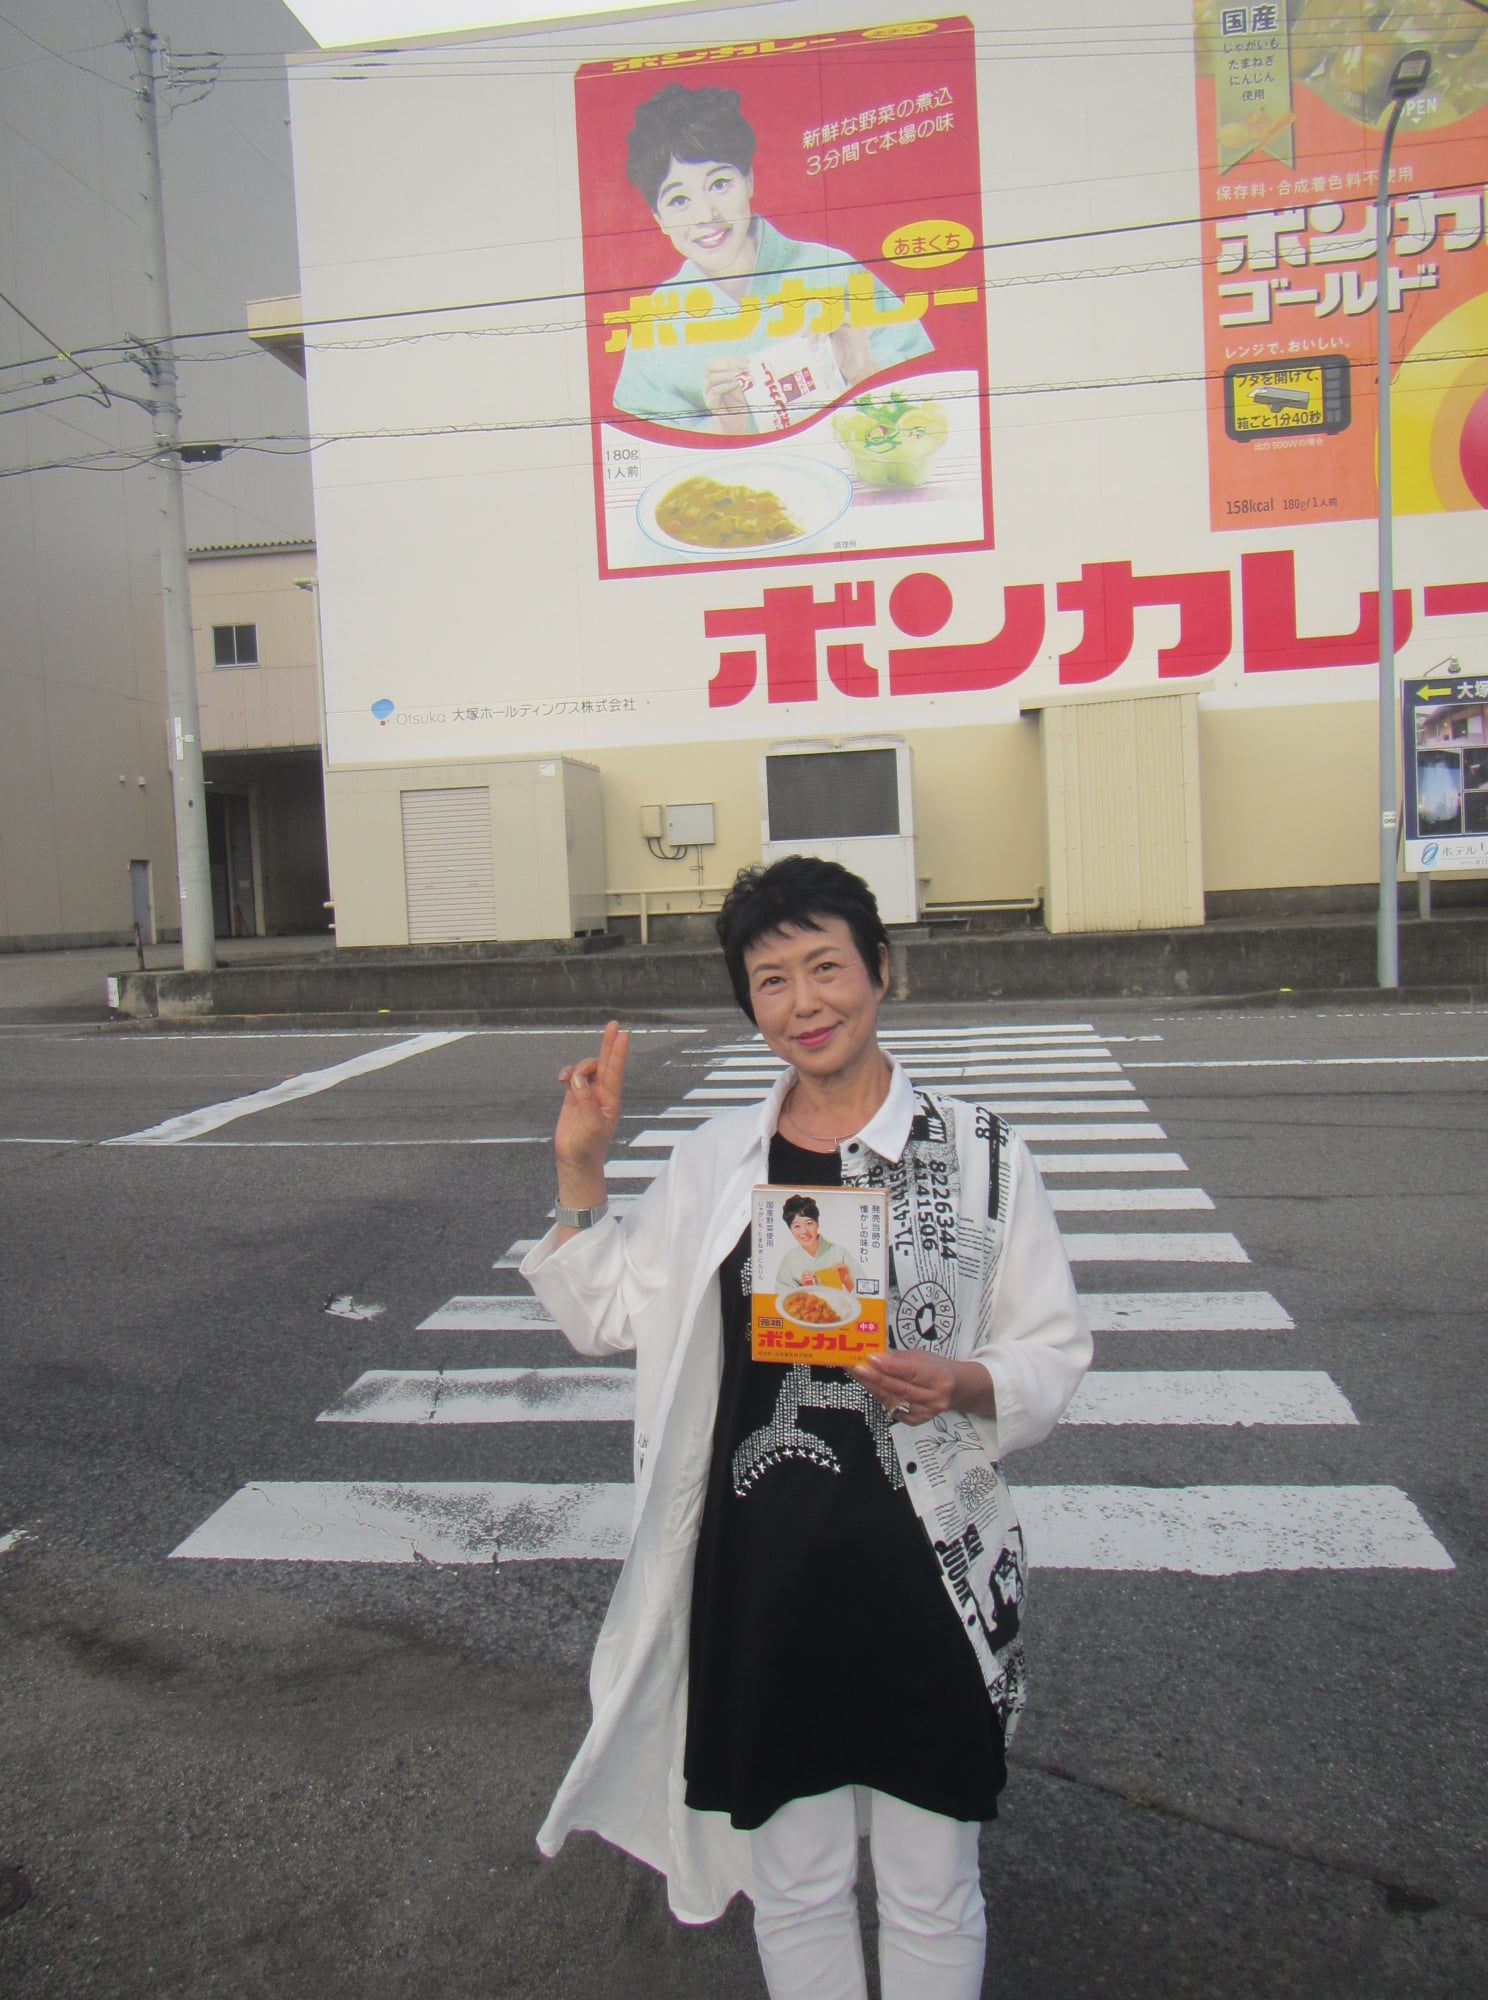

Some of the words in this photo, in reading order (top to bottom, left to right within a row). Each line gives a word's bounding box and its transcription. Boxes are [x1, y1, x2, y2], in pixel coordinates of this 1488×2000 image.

[1221, 5, 1278, 36] 国産
[1223, 38, 1279, 54] じゃがいも
[1228, 55, 1274, 70] たまねぎ
[1229, 73, 1275, 86] にんじん
[1242, 89, 1265, 101] 使用
[802, 86, 953, 150] 新鮮な野菜の煮込
[805, 113, 955, 176] 3分間で本場の味
[893, 232, 961, 256] あまくち
[1215, 191, 1488, 275] ボンカ
[1218, 263, 1440, 329] ゴールド
[603, 272, 979, 353] ボンカレー
[1236, 411, 1321, 430] 箱ごと1分40秒
[605, 447, 640, 463] 180g
[606, 465, 640, 479] 1人前
[1226, 499, 1274, 515] 158kcal
[704, 550, 1488, 708] ボンカレー
[396, 711, 446, 726] Otsuka
[452, 698, 635, 723] 大塚ホールディングス株式会社
[913, 1158, 937, 1251] 4141506
[929, 1160, 958, 1261] 8226344
[860, 1205, 868, 1263] 懐かしの味わい
[871, 1205, 880, 1249] 発売当時の
[925, 1286, 932, 1297] 3
[940, 1304, 951, 1313] 8
[860, 1322, 875, 1332] 中辛
[758, 1331, 880, 1352] ボンカレー
